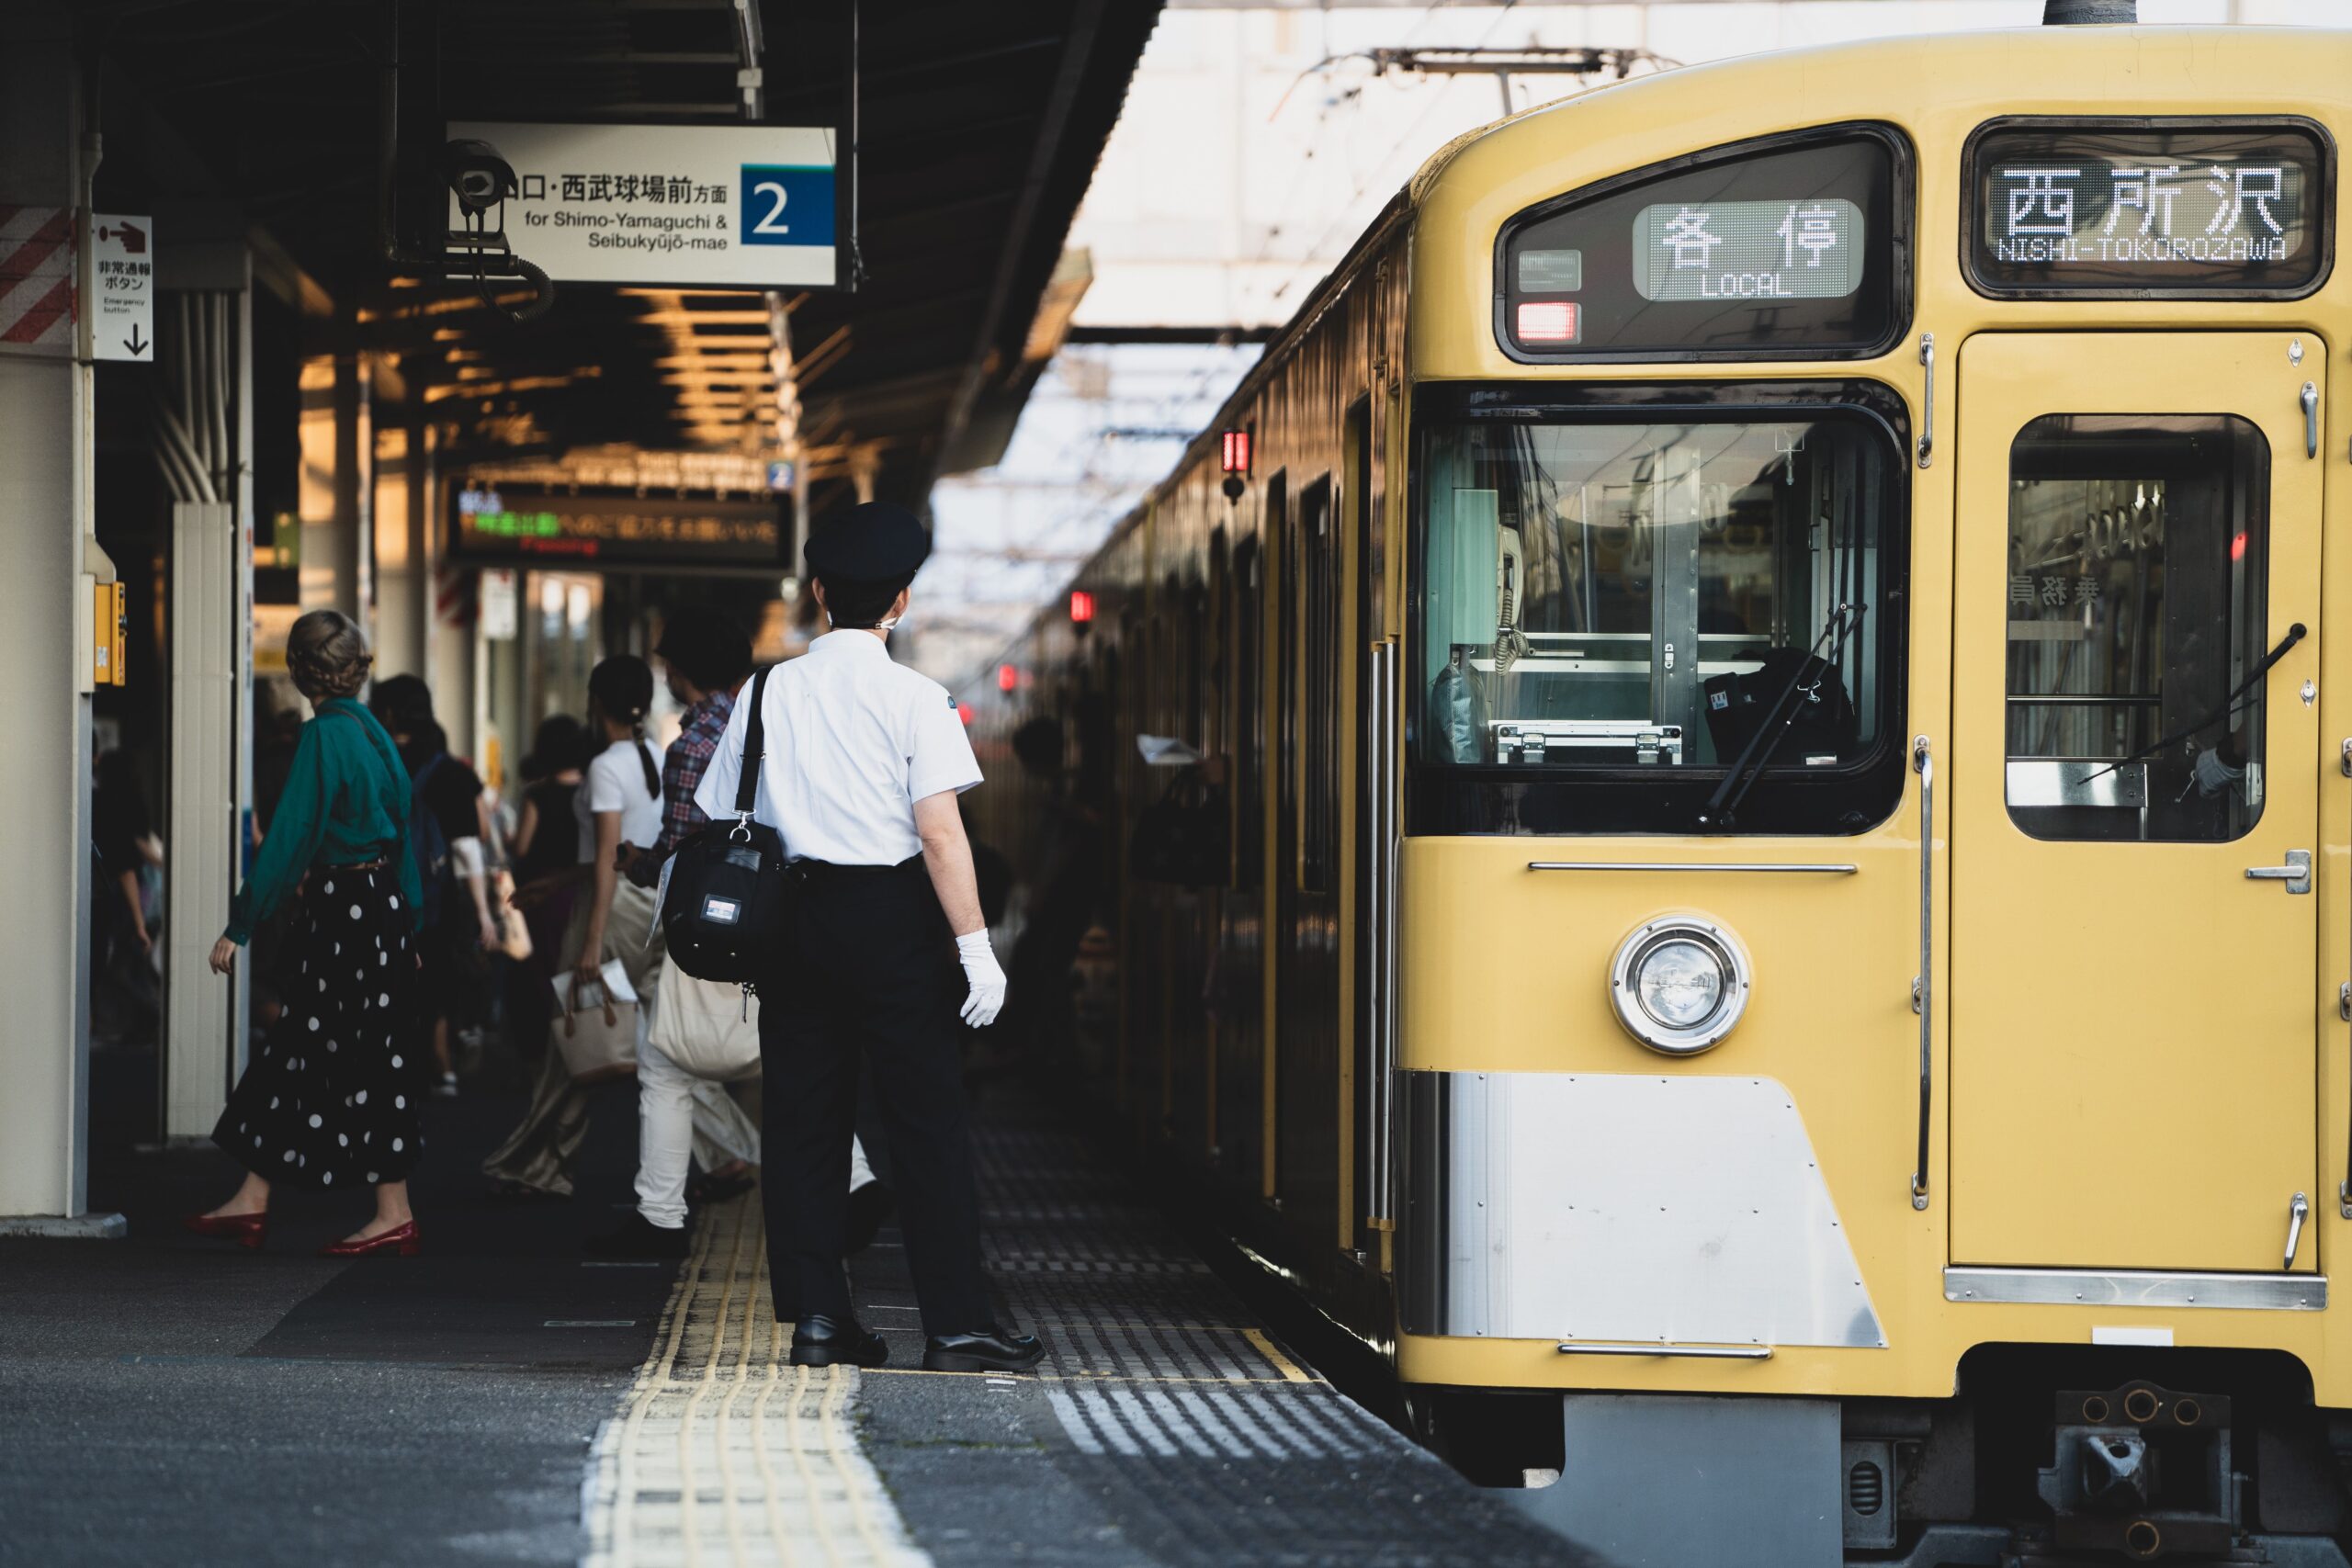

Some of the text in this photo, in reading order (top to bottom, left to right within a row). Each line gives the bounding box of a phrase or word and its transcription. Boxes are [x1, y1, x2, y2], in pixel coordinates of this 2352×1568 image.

[752, 183, 788, 233] 2
[2003, 165, 2284, 236] 西所沢
[525, 210, 728, 231] for Shimo-Yamaguchi &
[1997, 237, 2285, 261] NISHI-TOKOROZAWA
[98, 260, 151, 276] 非常通報
[105, 276, 143, 290] ボタン
[1702, 274, 1792, 297] LOCAL
[104, 297, 145, 306] Emergency
[104, 306, 130, 314] button
